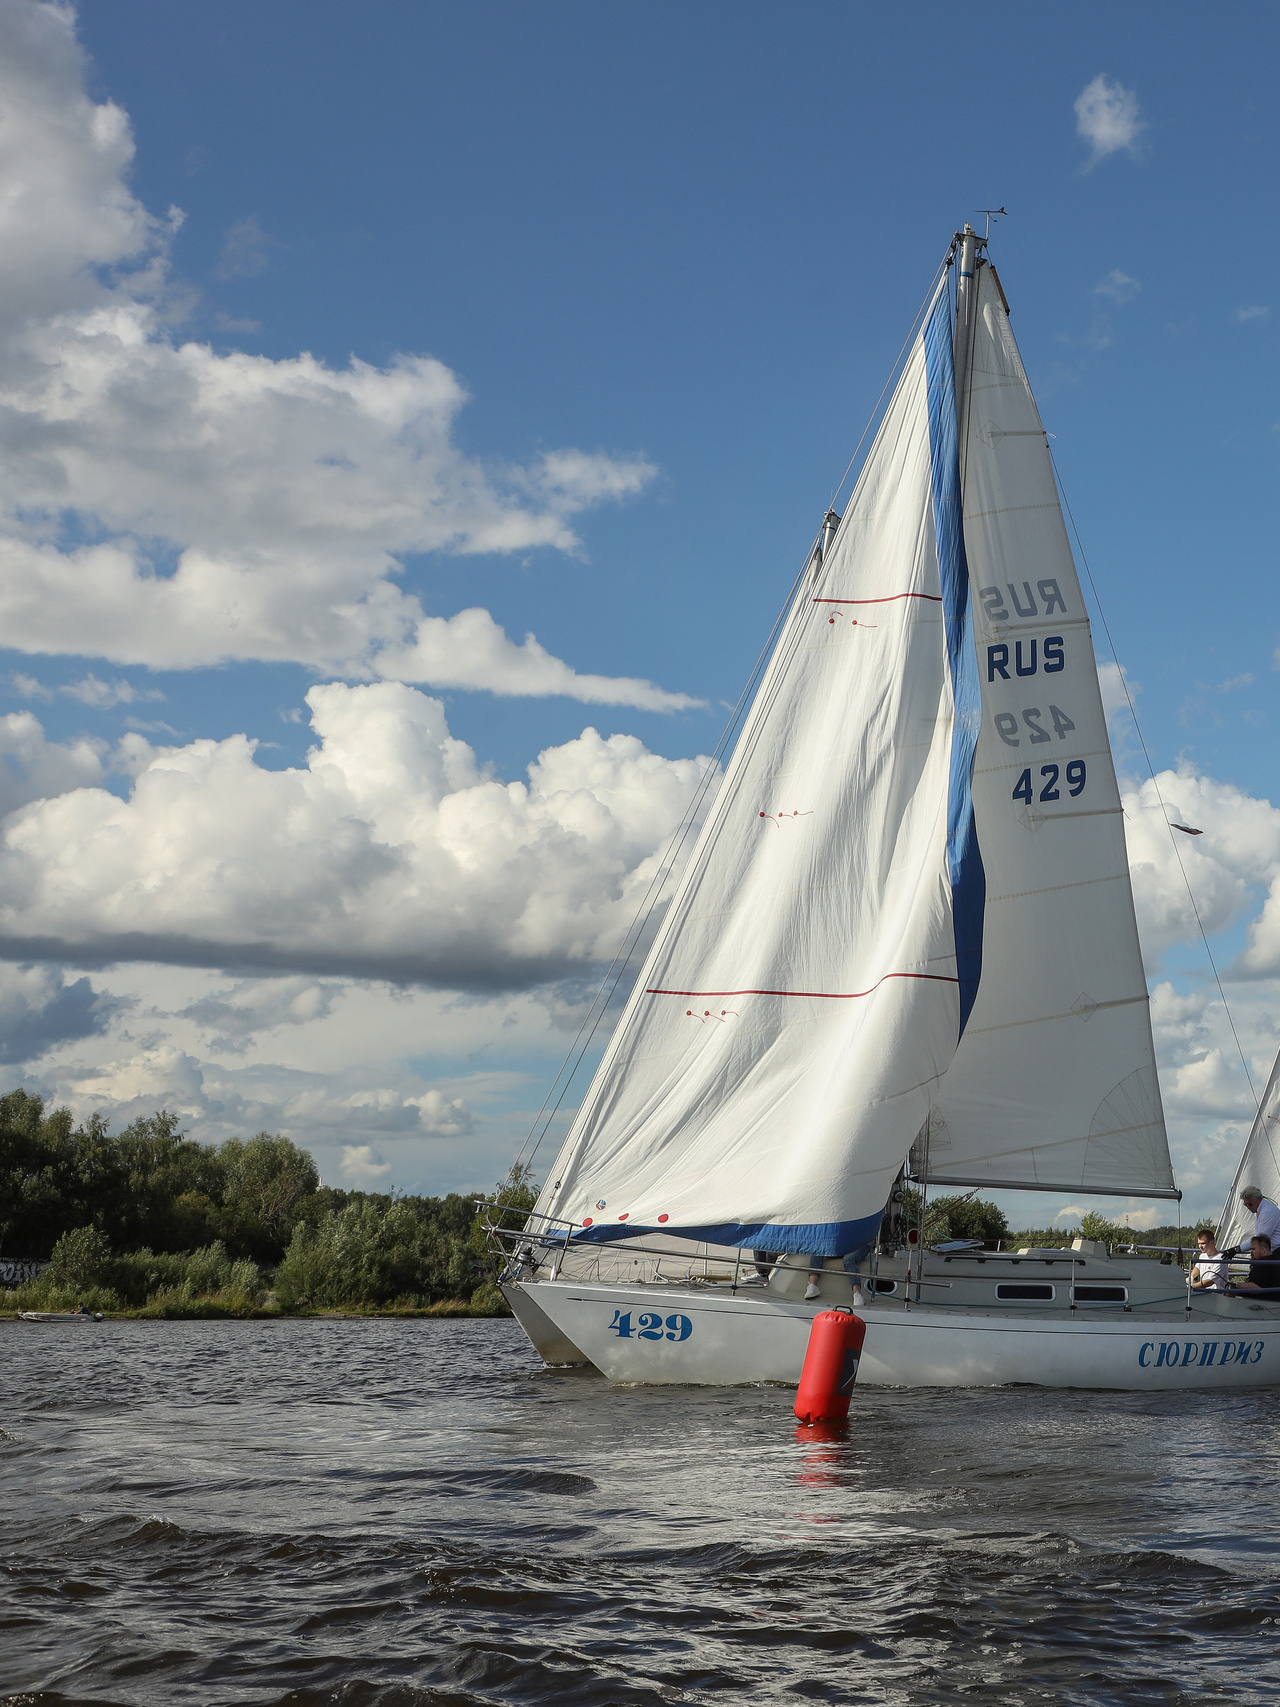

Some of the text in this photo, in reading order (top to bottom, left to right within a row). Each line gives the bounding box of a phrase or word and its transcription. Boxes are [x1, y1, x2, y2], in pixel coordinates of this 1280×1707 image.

[987, 636, 1065, 682] RUS
[1012, 759, 1087, 805] 429
[608, 1310, 693, 1342] 429
[1138, 1341, 1265, 1368] СЮРПРИЗ
